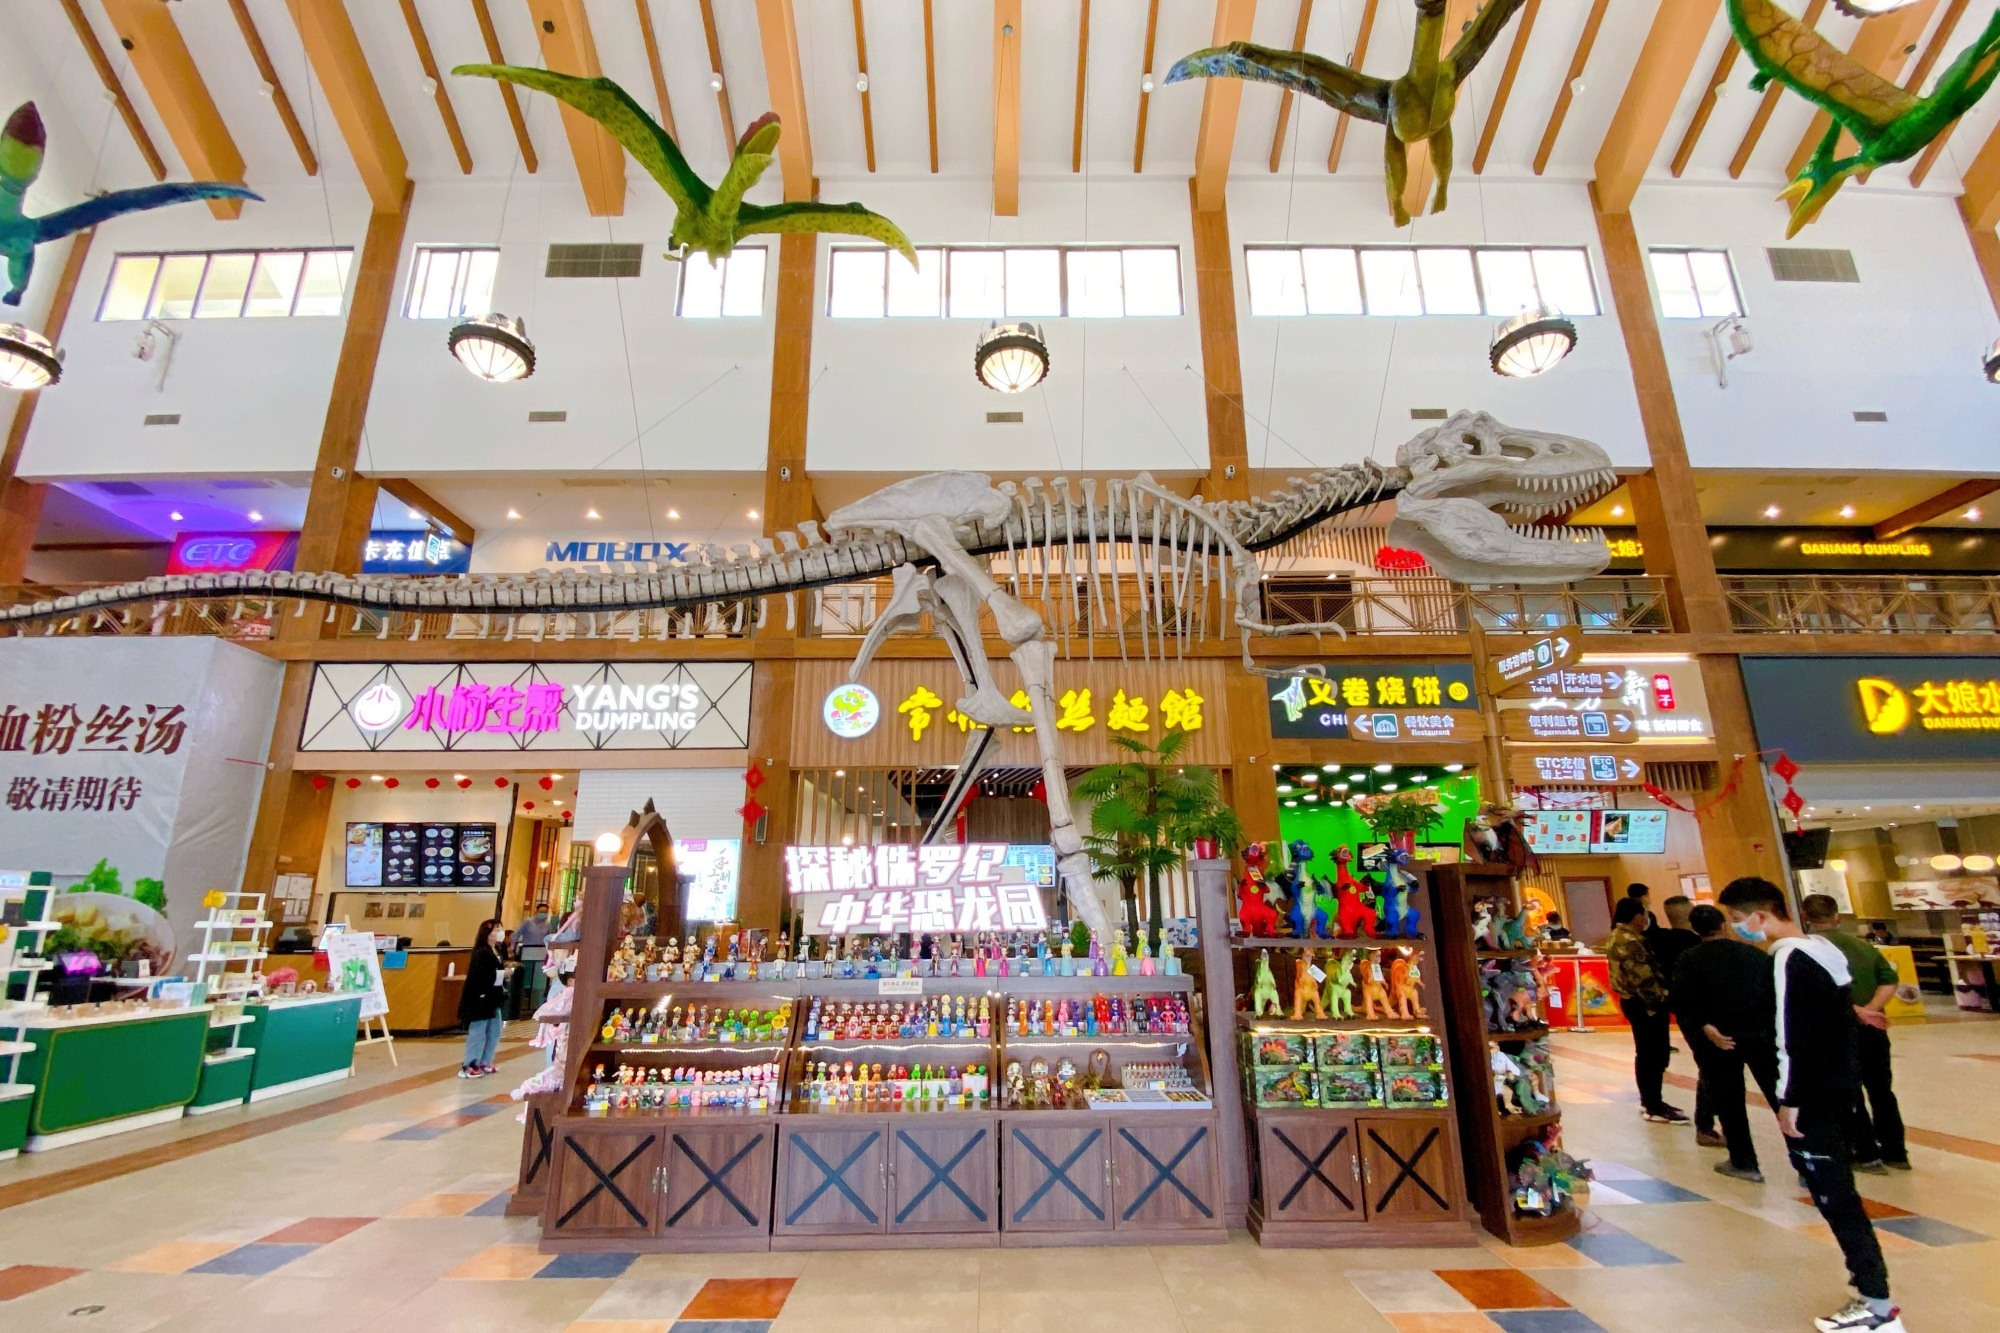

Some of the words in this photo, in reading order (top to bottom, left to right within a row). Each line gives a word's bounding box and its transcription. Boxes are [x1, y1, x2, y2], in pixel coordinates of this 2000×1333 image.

[184, 540, 255, 563] ETC
[545, 541, 690, 562] MOBOX
[1801, 542, 1862, 555] DANIANG
[1863, 543, 1932, 557] DUMPLING
[1565, 672, 1602, 685] 开水间
[1531, 685, 1553, 693] Toilet
[572, 684, 700, 711] YANG'S
[408, 683, 565, 733] 小杨生煎
[575, 711, 697, 731] DUMPLING
[1404, 714, 1455, 728] 餐饮美食
[1528, 714, 1579, 728] 便利超市
[1922, 716, 1981, 730] DANIANG
[1411, 728, 1450, 737] Restaurant
[1533, 728, 1580, 737] Supermarket
[1535, 756, 1587, 769] ETC充值
[1540, 769, 1585, 781] 请上二楼
[6, 776, 142, 811] 敬请期待
[784, 843, 1009, 893] 探秘侏罗纪
[818, 884, 1049, 933] 中华恐龙园
